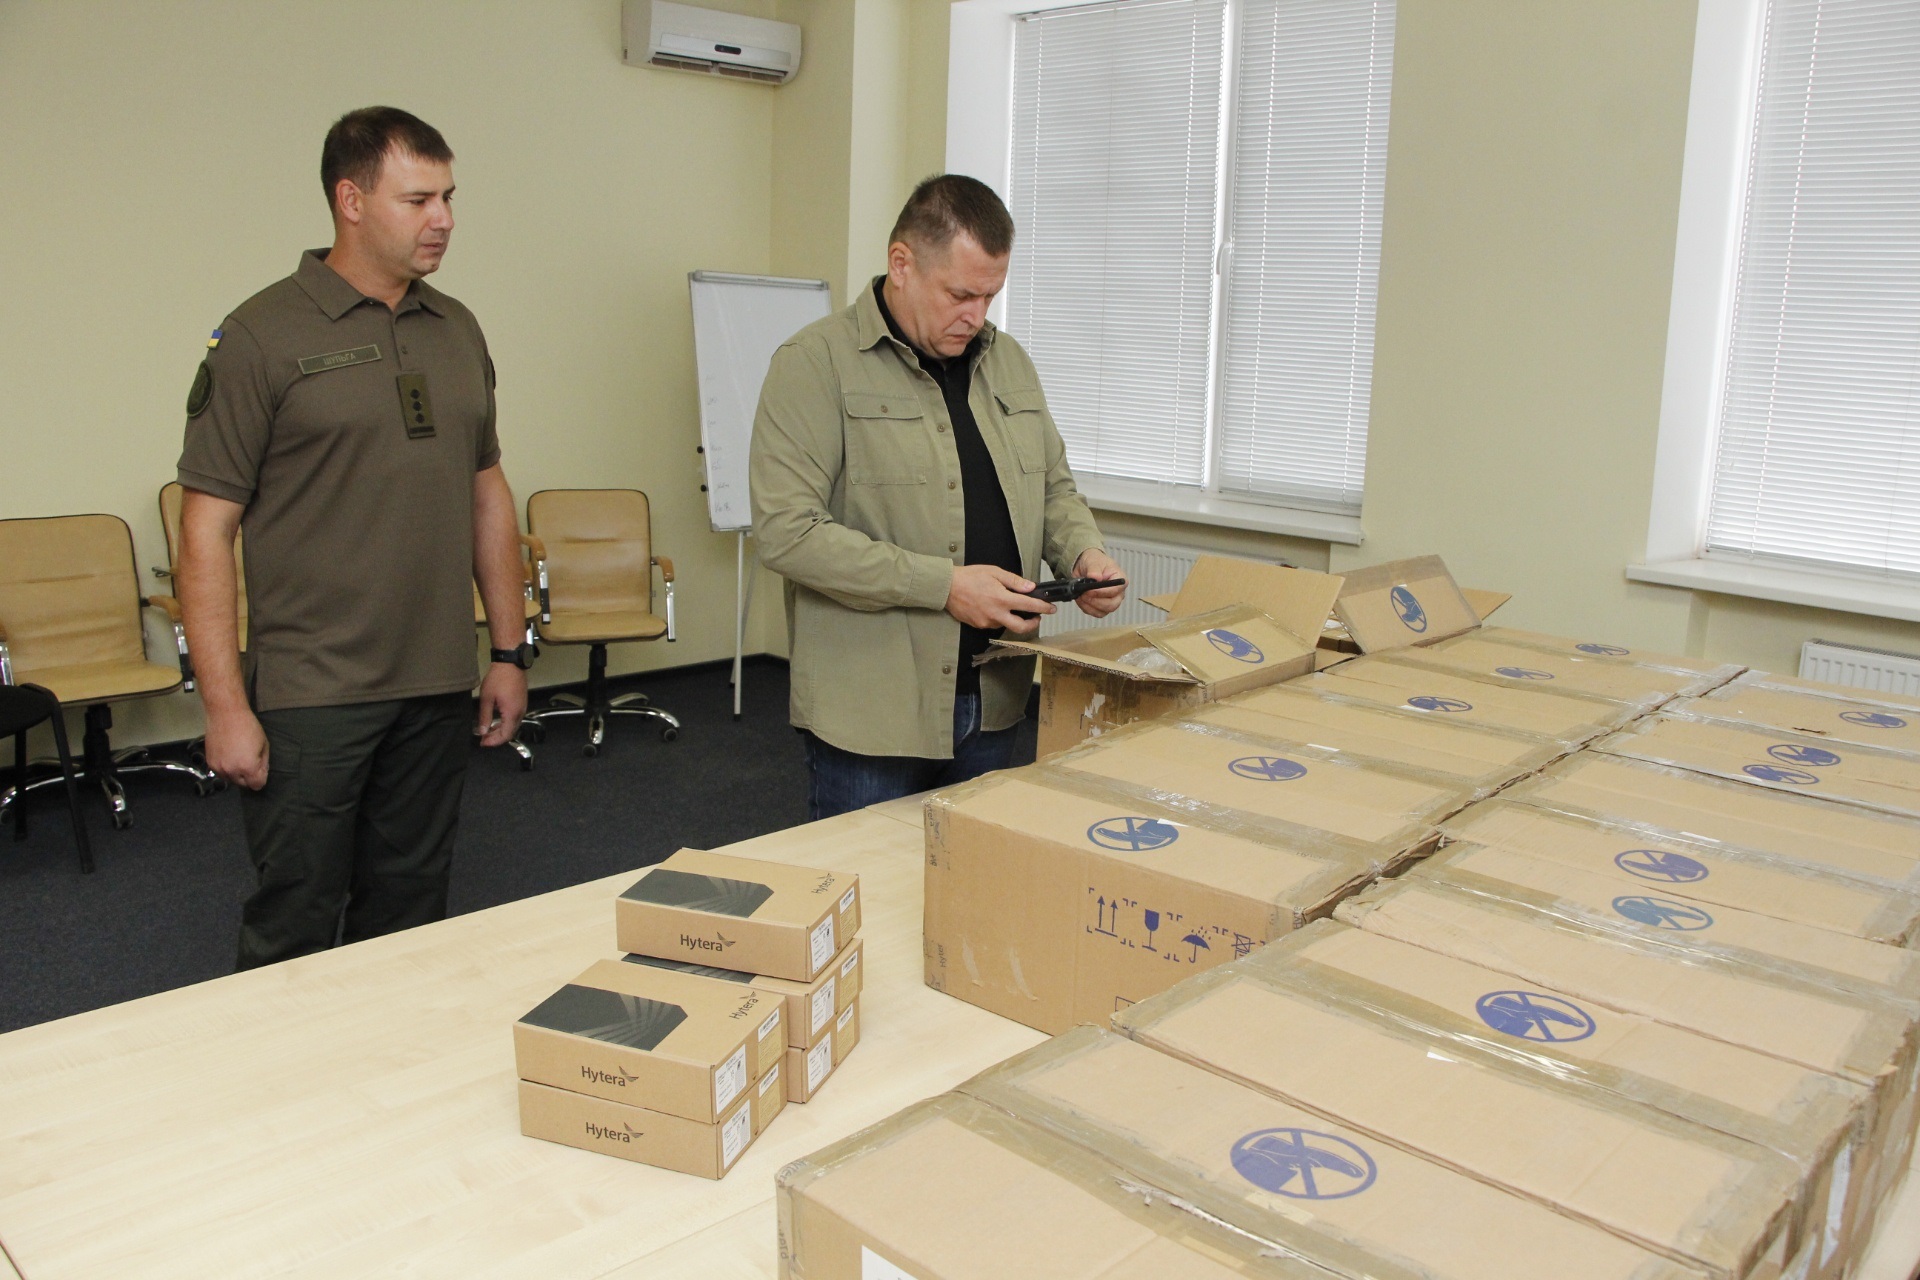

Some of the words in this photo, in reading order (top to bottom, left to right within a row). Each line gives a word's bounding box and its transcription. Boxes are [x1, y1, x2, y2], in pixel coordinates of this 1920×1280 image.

[811, 878, 835, 894] Hytera
[680, 933, 723, 952] Hytera
[729, 998, 759, 1020] Hytera
[581, 1065, 626, 1087] Hytera
[585, 1121, 631, 1144] Hytera
